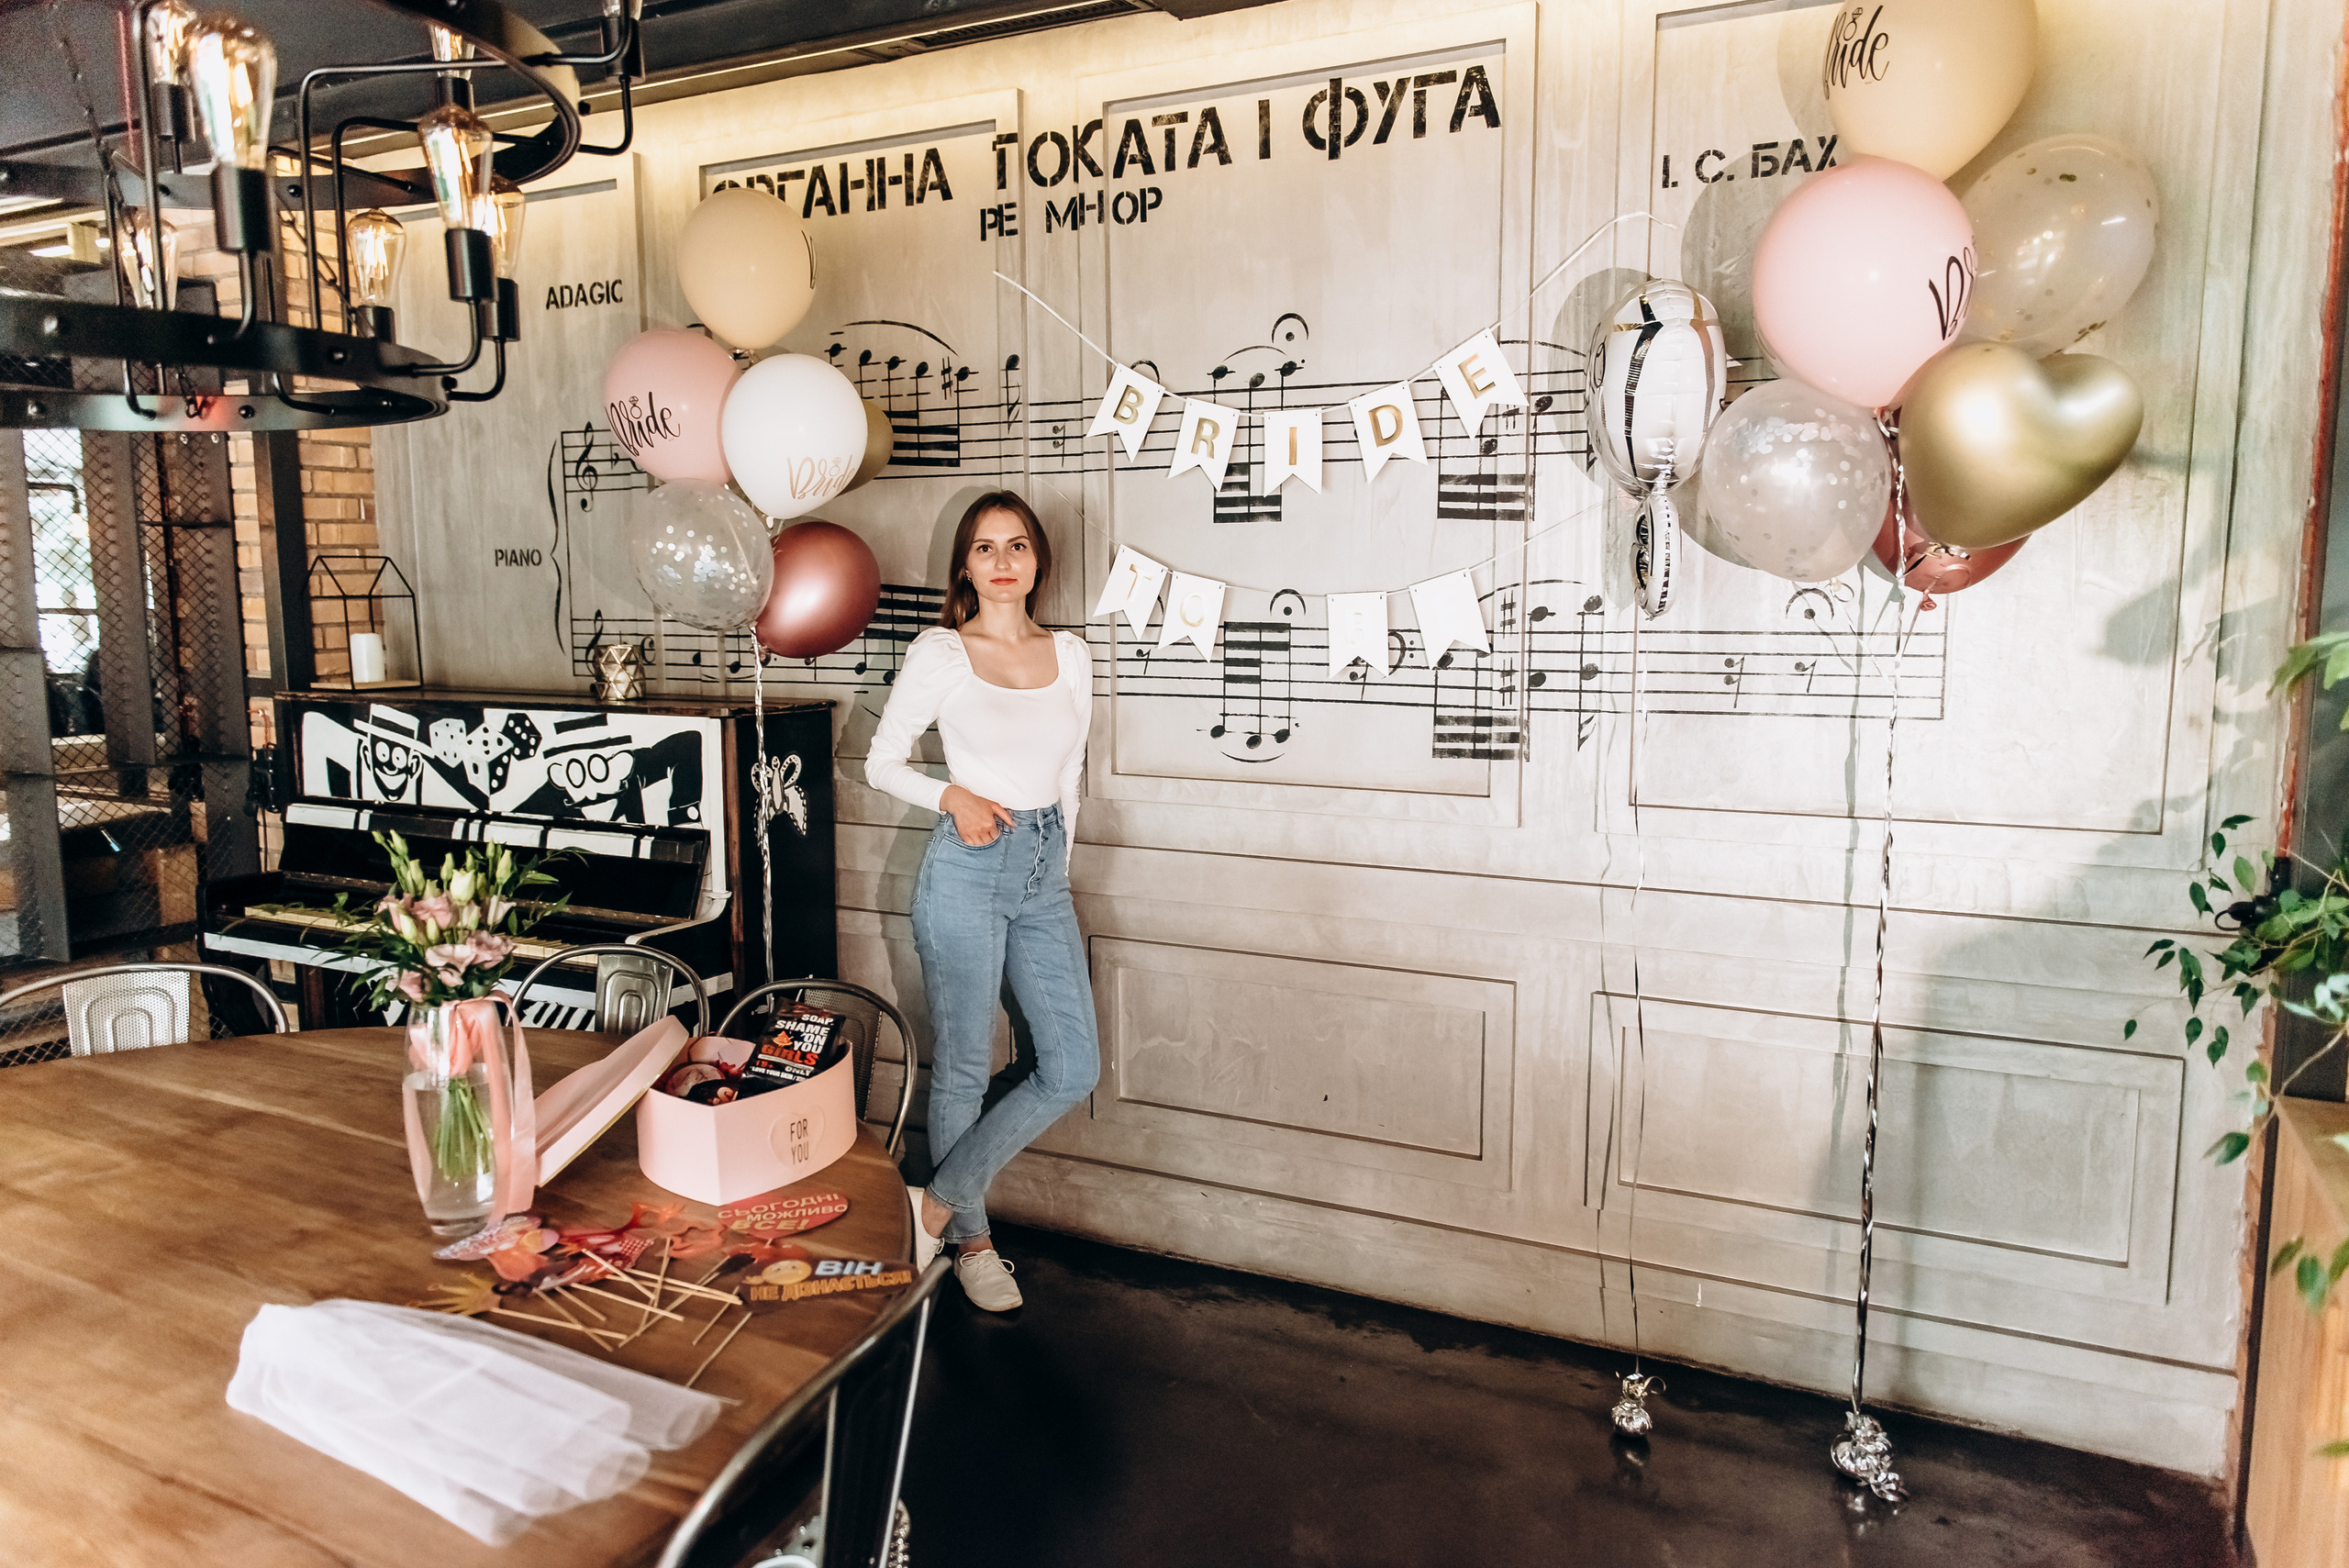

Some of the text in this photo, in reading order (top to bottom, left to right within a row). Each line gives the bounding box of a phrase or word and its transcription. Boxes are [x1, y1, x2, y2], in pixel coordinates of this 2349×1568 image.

[712, 148, 953, 218] ГАННА
[992, 106, 1233, 190] ТОКАТА
[1302, 65, 1502, 161] ФУГА
[1695, 149, 1735, 183] С.
[1751, 134, 1839, 179] БАХ
[980, 202, 1019, 242] РЕ
[1113, 352, 1497, 465] BRIDE
[495, 549, 542, 567] PIANO
[1129, 562, 1208, 628] TO
[774, 1019, 830, 1037] SHAME
[761, 1044, 819, 1066] GIRLS
[794, 1040, 823, 1054] YOU
[785, 1065, 812, 1076] ONLY
[790, 1118, 808, 1142] FOR
[791, 1141, 809, 1165] YOU
[718, 1194, 839, 1219] СЬОГОДНІ
[747, 1204, 848, 1222] МОЖЛИВО
[730, 1218, 809, 1231] ВСЕ!
[815, 1261, 884, 1275] ВІН
[750, 1285, 780, 1301] НЕ
